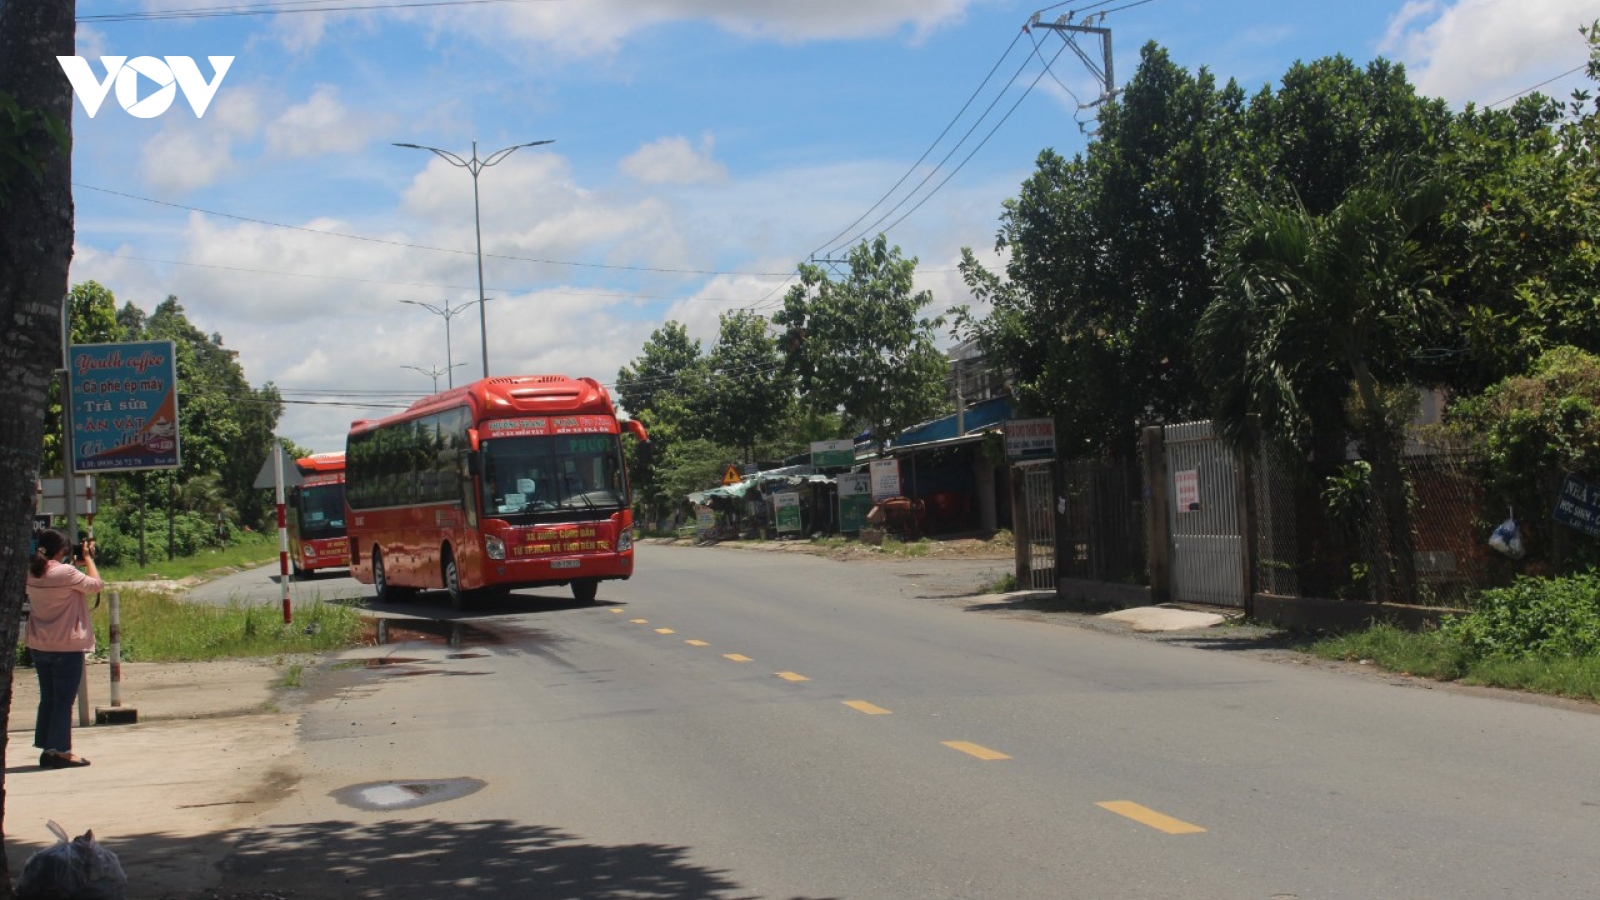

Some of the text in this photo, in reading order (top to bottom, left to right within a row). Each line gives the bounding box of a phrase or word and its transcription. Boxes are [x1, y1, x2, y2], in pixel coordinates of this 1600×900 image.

[75, 351, 164, 375] Youth coffee
[100, 378, 120, 395] phê
[124, 376, 137, 394] ép
[140, 376, 163, 391] máy
[83, 398, 147, 412] Trà sữa
[854, 481, 867, 492] 41
